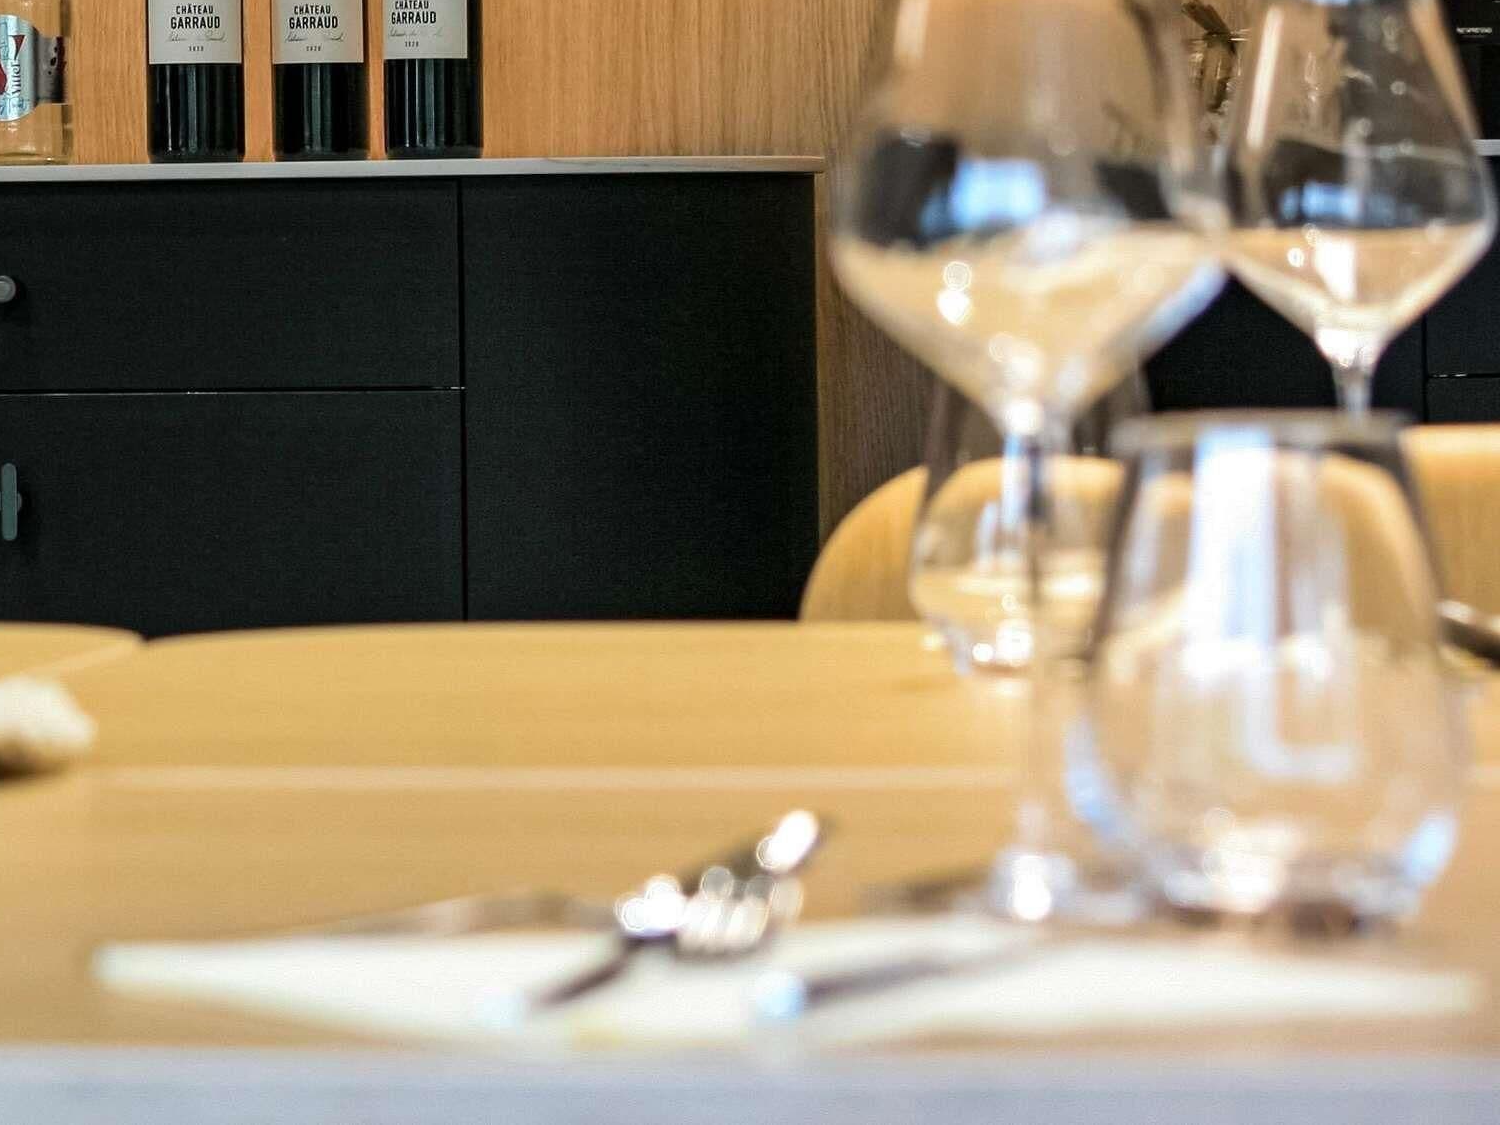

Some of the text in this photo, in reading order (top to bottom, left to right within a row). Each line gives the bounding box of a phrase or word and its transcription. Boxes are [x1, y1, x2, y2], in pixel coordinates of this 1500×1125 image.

[176, 3, 214, 15] CHÂTEAU
[293, 3, 332, 15] CHÂTEAU
[170, 17, 221, 30] GARRAUD
[289, 16, 339, 29] GARRAUD
[391, 11, 437, 25] GARRAUD
